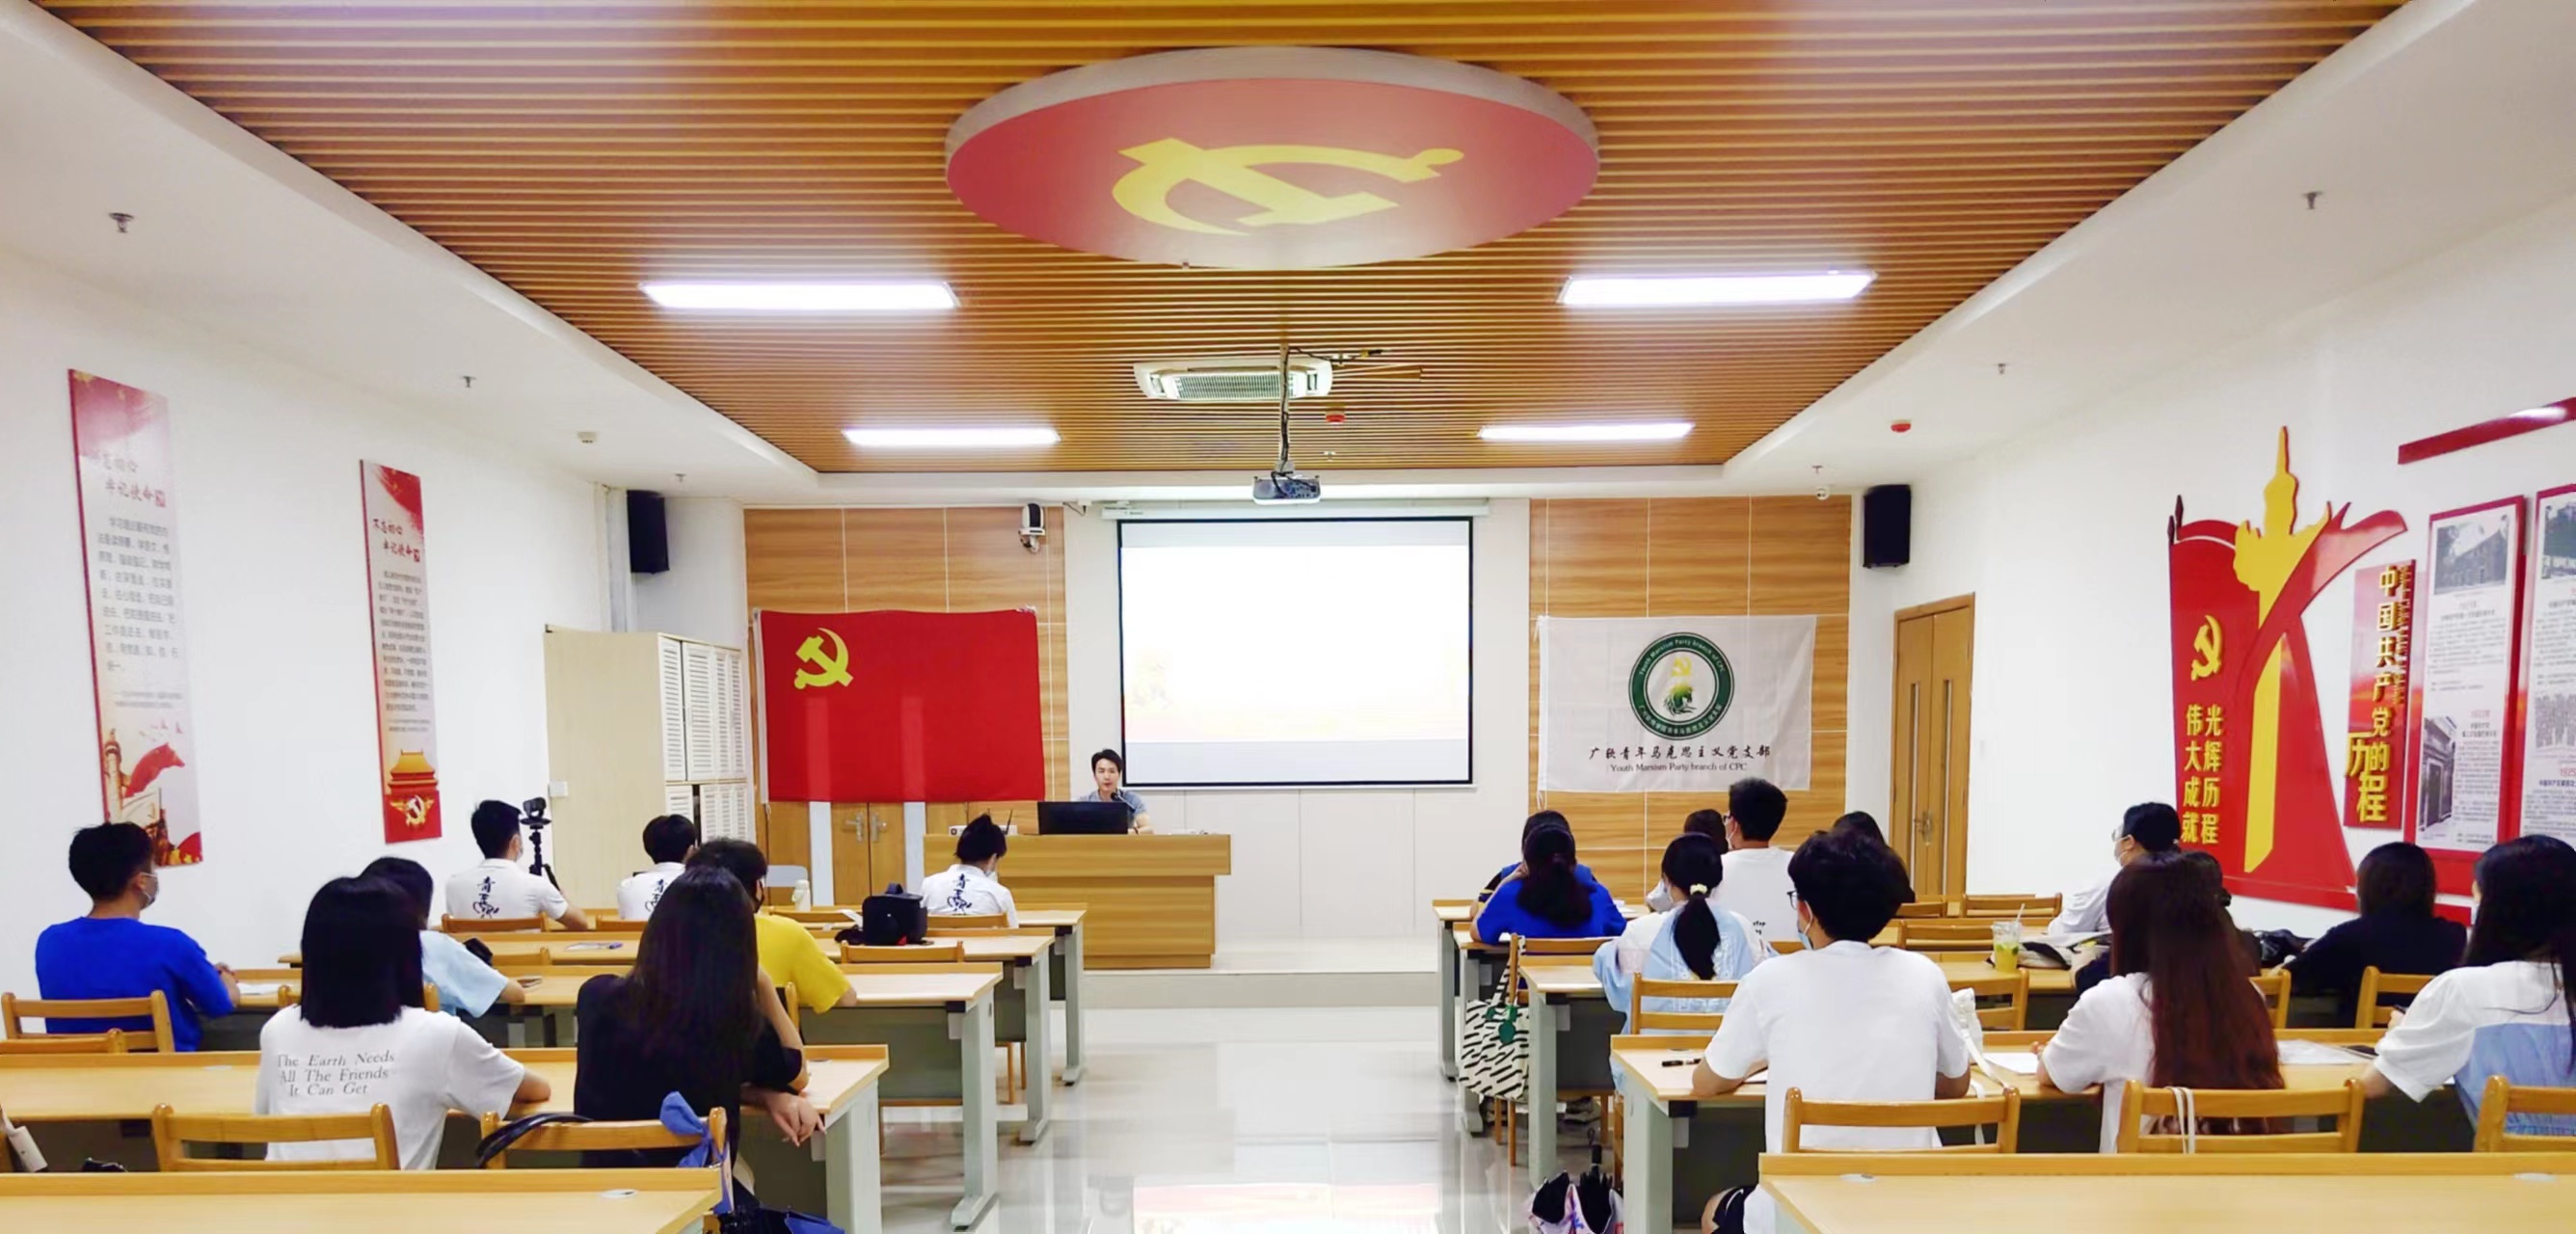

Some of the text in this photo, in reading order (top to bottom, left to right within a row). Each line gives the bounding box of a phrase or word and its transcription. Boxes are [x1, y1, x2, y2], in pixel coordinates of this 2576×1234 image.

[2371, 565, 2399, 771] 中国共产党的
[1610, 764, 1634, 772] Youth
[1669, 762, 1689, 772] Party
[1690, 763, 1717, 771] branch
[1718, 763, 1728, 771] of
[1729, 763, 1748, 771] CPC
[2181, 704, 2203, 844] 伟大成就
[2201, 704, 2223, 845] 光辉历程
[2346, 732, 2388, 822] 历程
[278, 1050, 394, 1067] The Earth Needs
[281, 1066, 388, 1083] All The Friends
[289, 1082, 367, 1096] It Can Get
